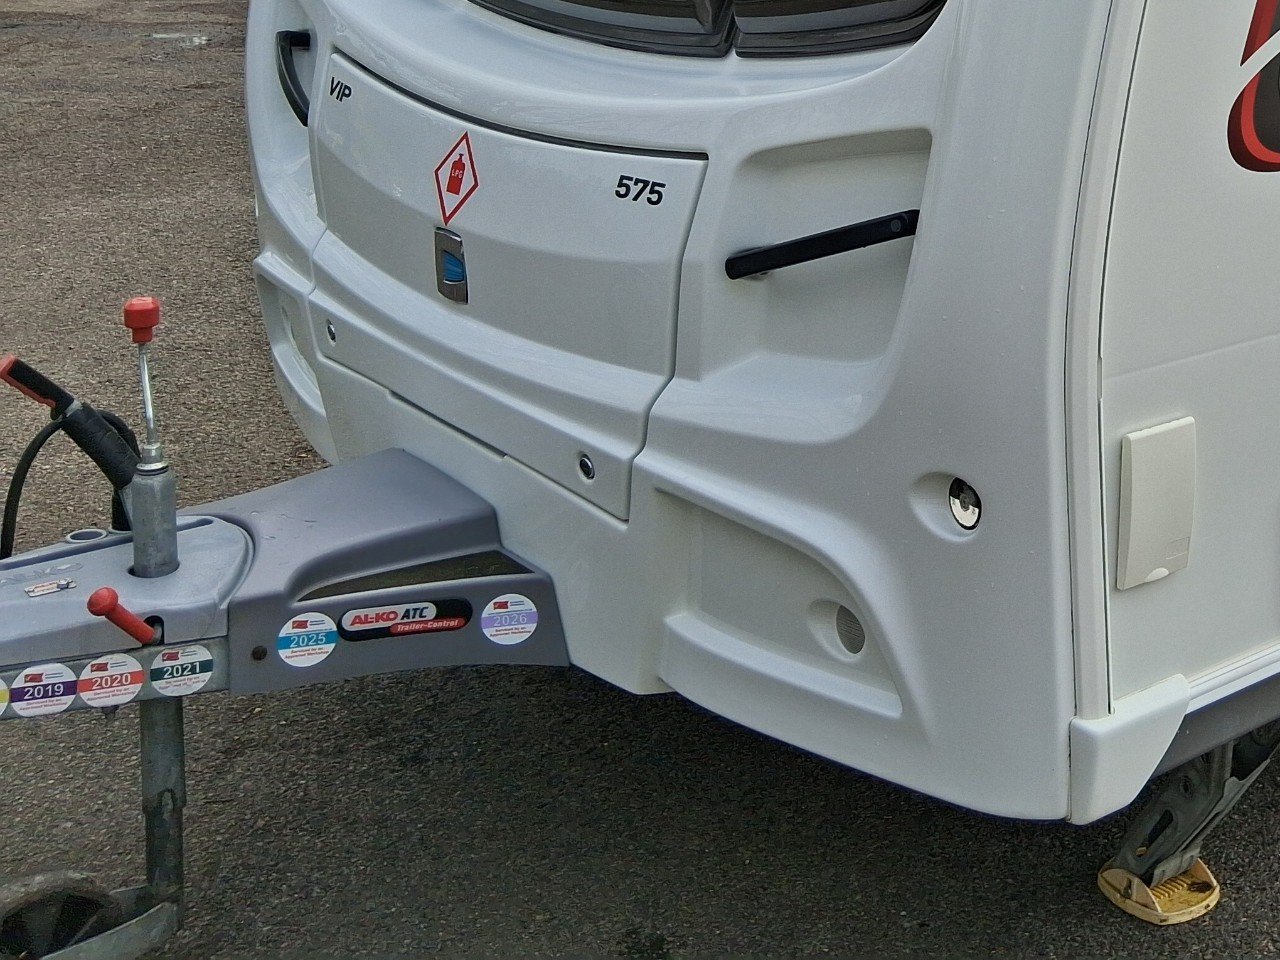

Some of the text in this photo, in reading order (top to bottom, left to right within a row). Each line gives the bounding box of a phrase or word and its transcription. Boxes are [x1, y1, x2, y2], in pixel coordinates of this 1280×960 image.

[330, 76, 352, 102] VIP
[451, 169, 464, 179] LPG
[614, 174, 667, 206] 575
[350, 606, 429, 626] AL-KO ATC
[493, 613, 528, 627] 2026
[397, 620, 460, 632] Trailer-Control
[289, 632, 327, 648] 2025
[163, 661, 200, 679] 2021
[91, 673, 131, 690] 2020
[23, 683, 64, 700] 2019
